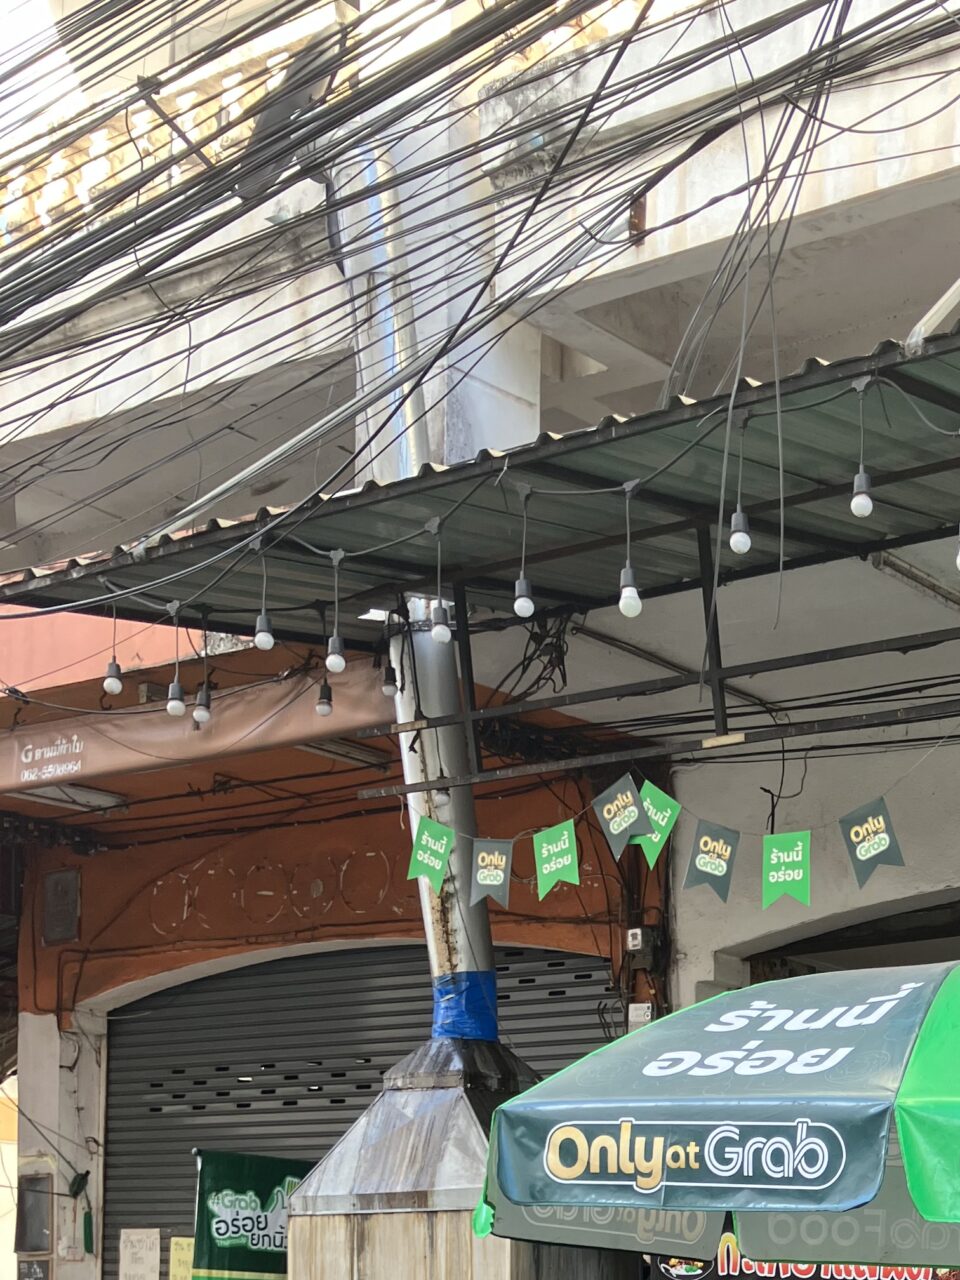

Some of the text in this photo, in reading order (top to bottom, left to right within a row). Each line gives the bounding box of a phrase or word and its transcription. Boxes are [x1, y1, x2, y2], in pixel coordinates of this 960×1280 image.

[603, 790, 633, 820] Only
[610, 806, 638, 834] Grab
[850, 815, 885, 843] Only
[421, 831, 447, 853] ร้านนี้
[541, 831, 570, 858] ร้านนี้
[700, 835, 732, 861] Only
[770, 841, 803, 864] ร้านนี้
[858, 834, 889, 859] Grab
[417, 850, 442, 870] อร่อย
[478, 851, 506, 869] Only
[543, 853, 572, 874] อร่อย
[697, 855, 726, 875] Grab
[478, 870, 503, 884] Grab
[769, 866, 803, 883] อร่อย
[704, 981, 926, 1033] ร้านนี้
[642, 1040, 855, 1078] อร่อย
[548, 1120, 829, 1190] Only at Grab
[215, 1210, 268, 1236] อร่อย
[250, 1225, 288, 1249] ยกนิ้
